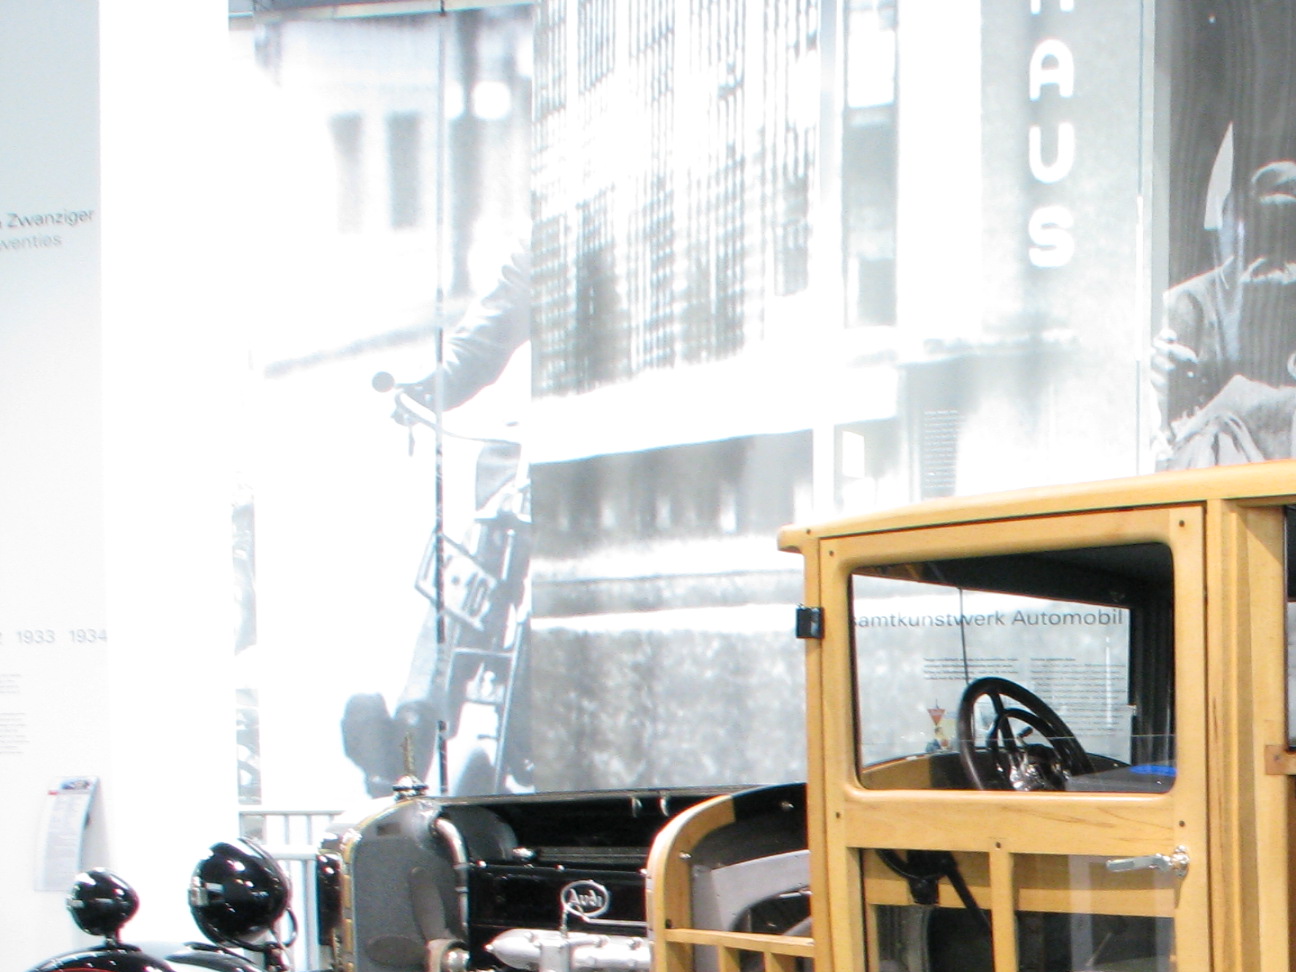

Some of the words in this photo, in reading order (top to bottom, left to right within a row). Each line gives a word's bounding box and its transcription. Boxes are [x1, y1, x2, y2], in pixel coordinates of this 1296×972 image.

[1029, 0, 1075, 268] AUS
[7, 208, 95, 228] Zwanziger
[1011, 608, 1123, 626] Automobil
[15, 629, 55, 645] 1933
[68, 628, 107, 644] 1934
